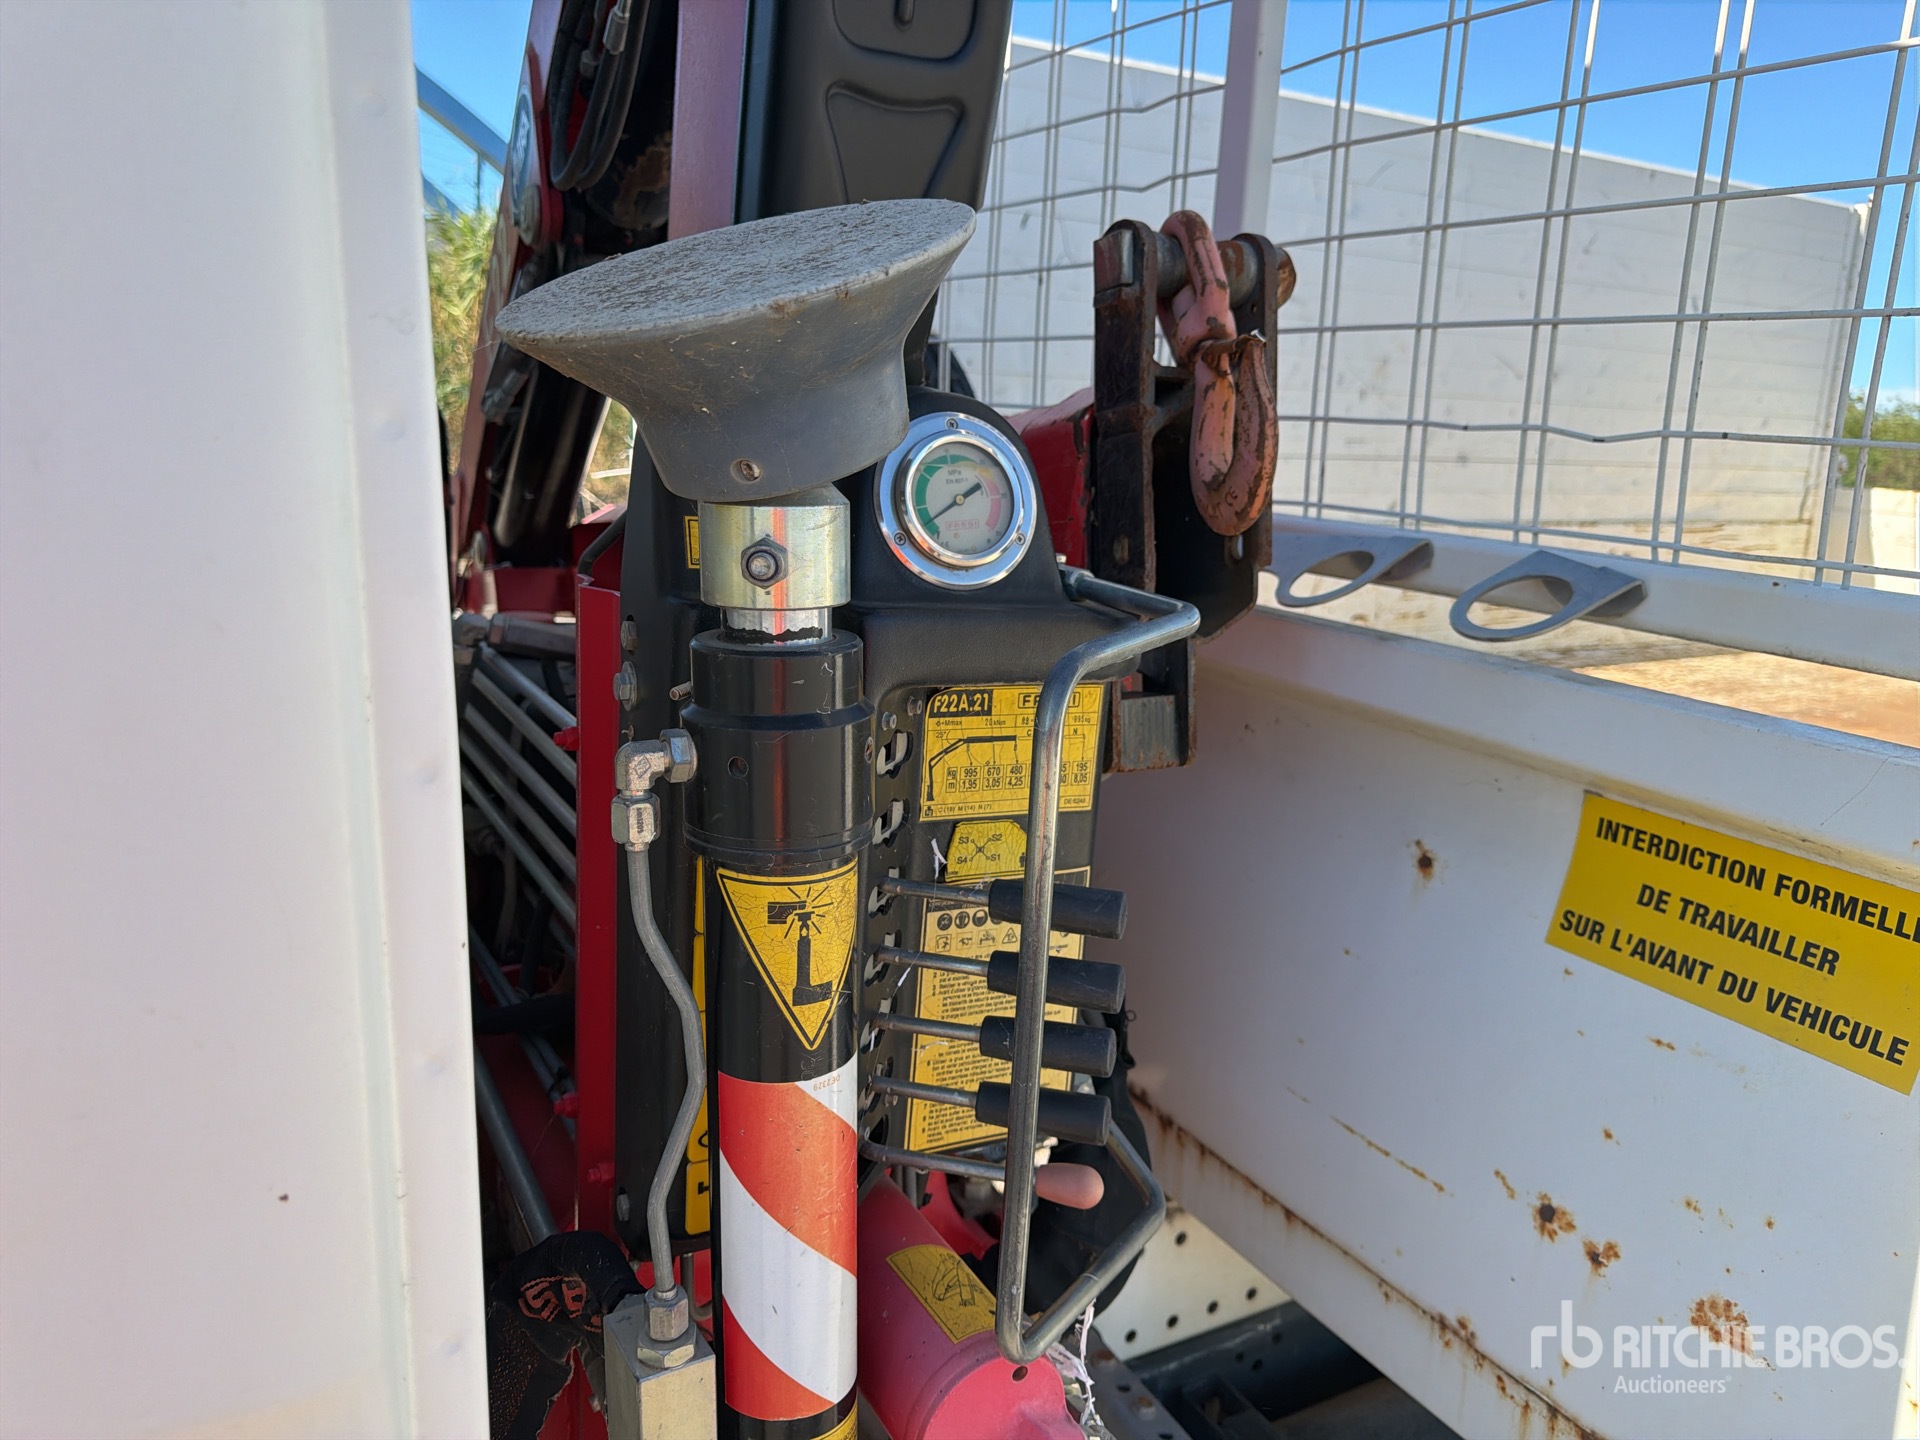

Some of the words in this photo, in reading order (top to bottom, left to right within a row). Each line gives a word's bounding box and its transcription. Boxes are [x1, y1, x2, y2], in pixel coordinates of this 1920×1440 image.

[933, 693, 989, 713] F22A.21
[947, 768, 957, 780] kg
[963, 767, 978, 778] 995
[986, 766, 1001, 777] 670
[1009, 765, 1023, 776] 480
[948, 781, 955, 790] m
[962, 779, 978, 791] 1,95
[985, 777, 1001, 789] 3,05
[1007, 776, 1023, 788] 4,25
[958, 836, 969, 845] S3
[991, 833, 1003, 842] S2
[956, 856, 968, 864] S4
[990, 853, 1001, 862] S1
[1596, 817, 1765, 890] INTERDICTION
[1636, 884, 1671, 914] DE
[1679, 897, 1840, 976] TRAVAILLER
[1560, 909, 1605, 944] SUR
[1610, 929, 1713, 985] L'AVANT
[1718, 970, 1758, 1003] DU
[1765, 987, 1910, 1066] VEHICULE
